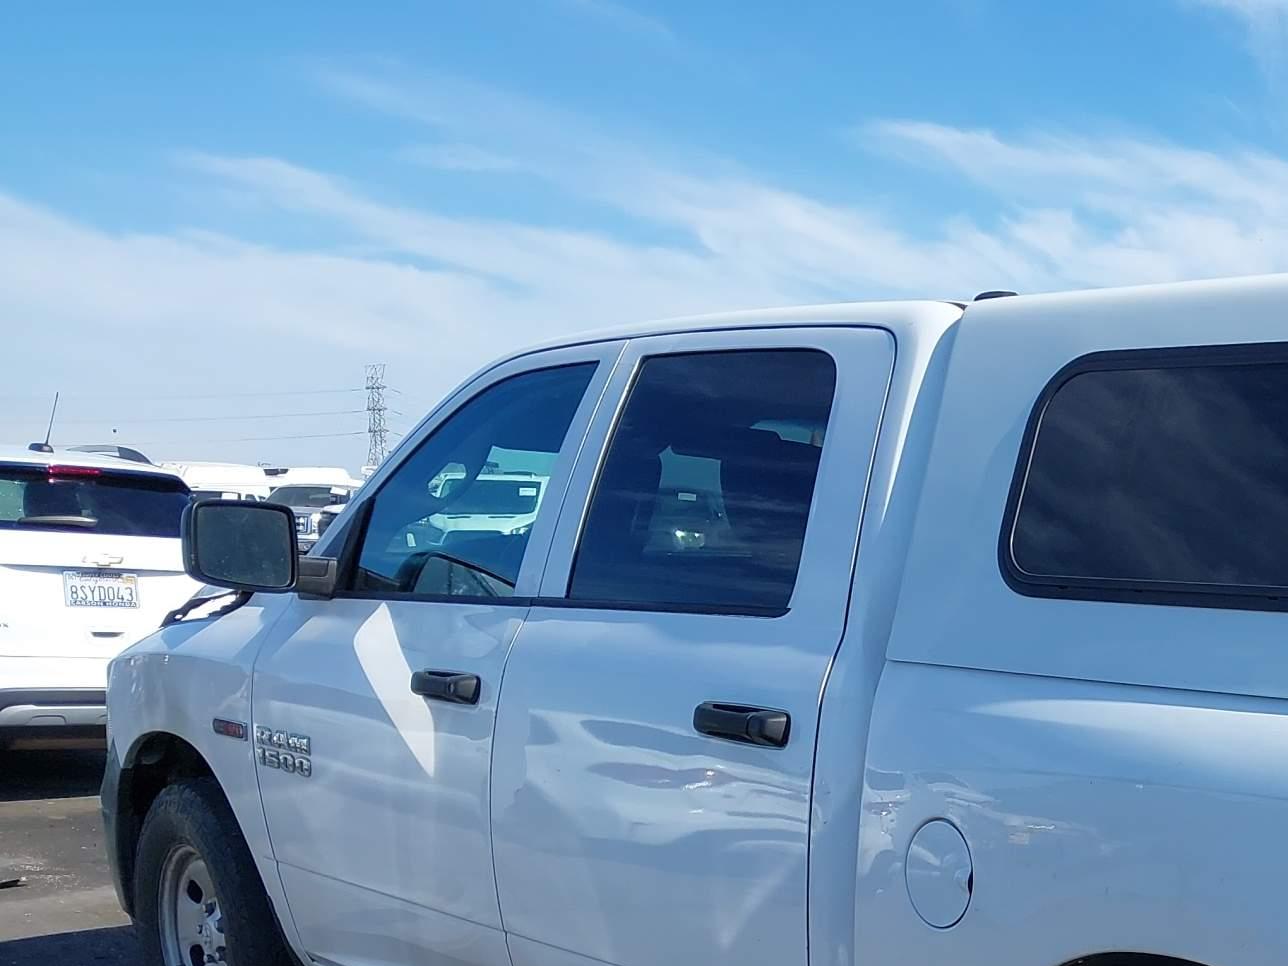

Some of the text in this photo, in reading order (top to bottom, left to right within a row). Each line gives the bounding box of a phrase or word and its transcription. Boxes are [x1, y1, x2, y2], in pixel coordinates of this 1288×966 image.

[70, 585, 134, 602] 8SYD043
[256, 726, 311, 756] RAM
[257, 747, 312, 778] 1500
